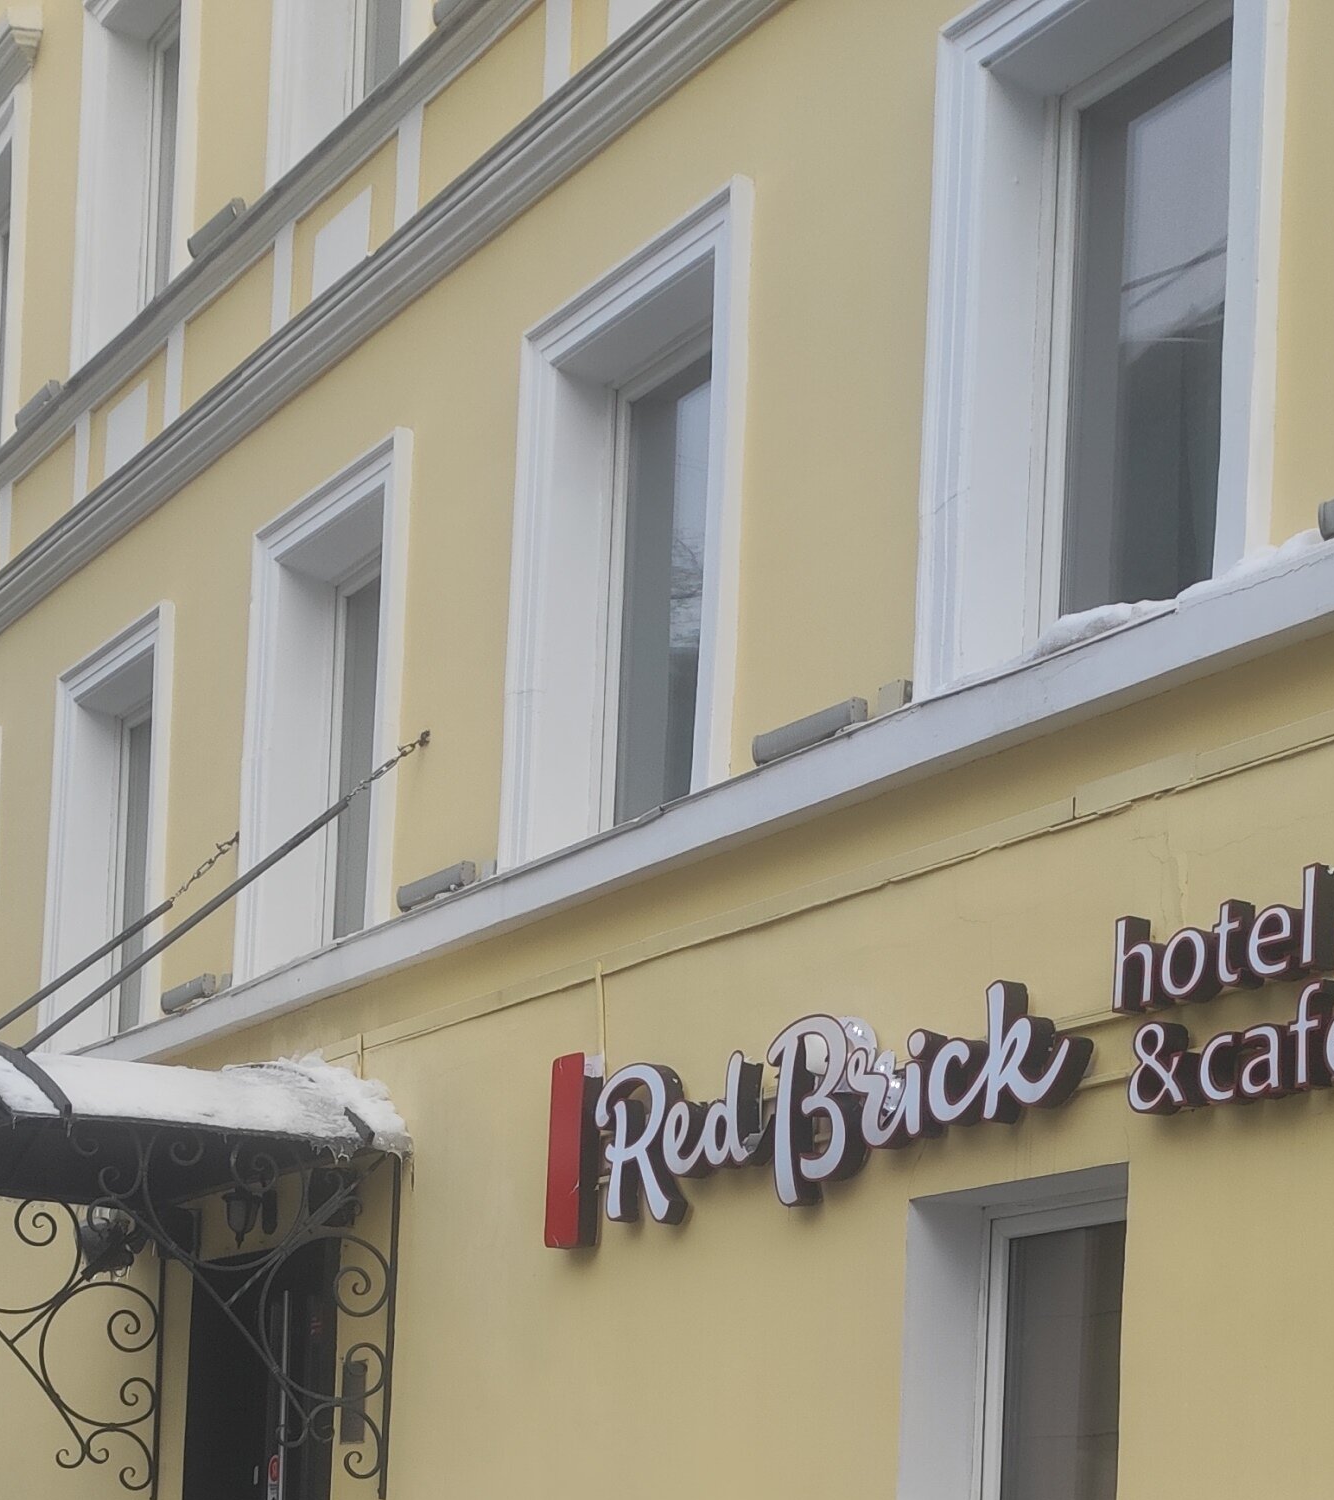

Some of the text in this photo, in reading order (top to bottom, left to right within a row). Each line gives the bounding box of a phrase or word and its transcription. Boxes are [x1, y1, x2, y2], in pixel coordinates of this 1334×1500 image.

[1112, 863, 1329, 1013] hotel
[594, 980, 1075, 1223] Red Brick
